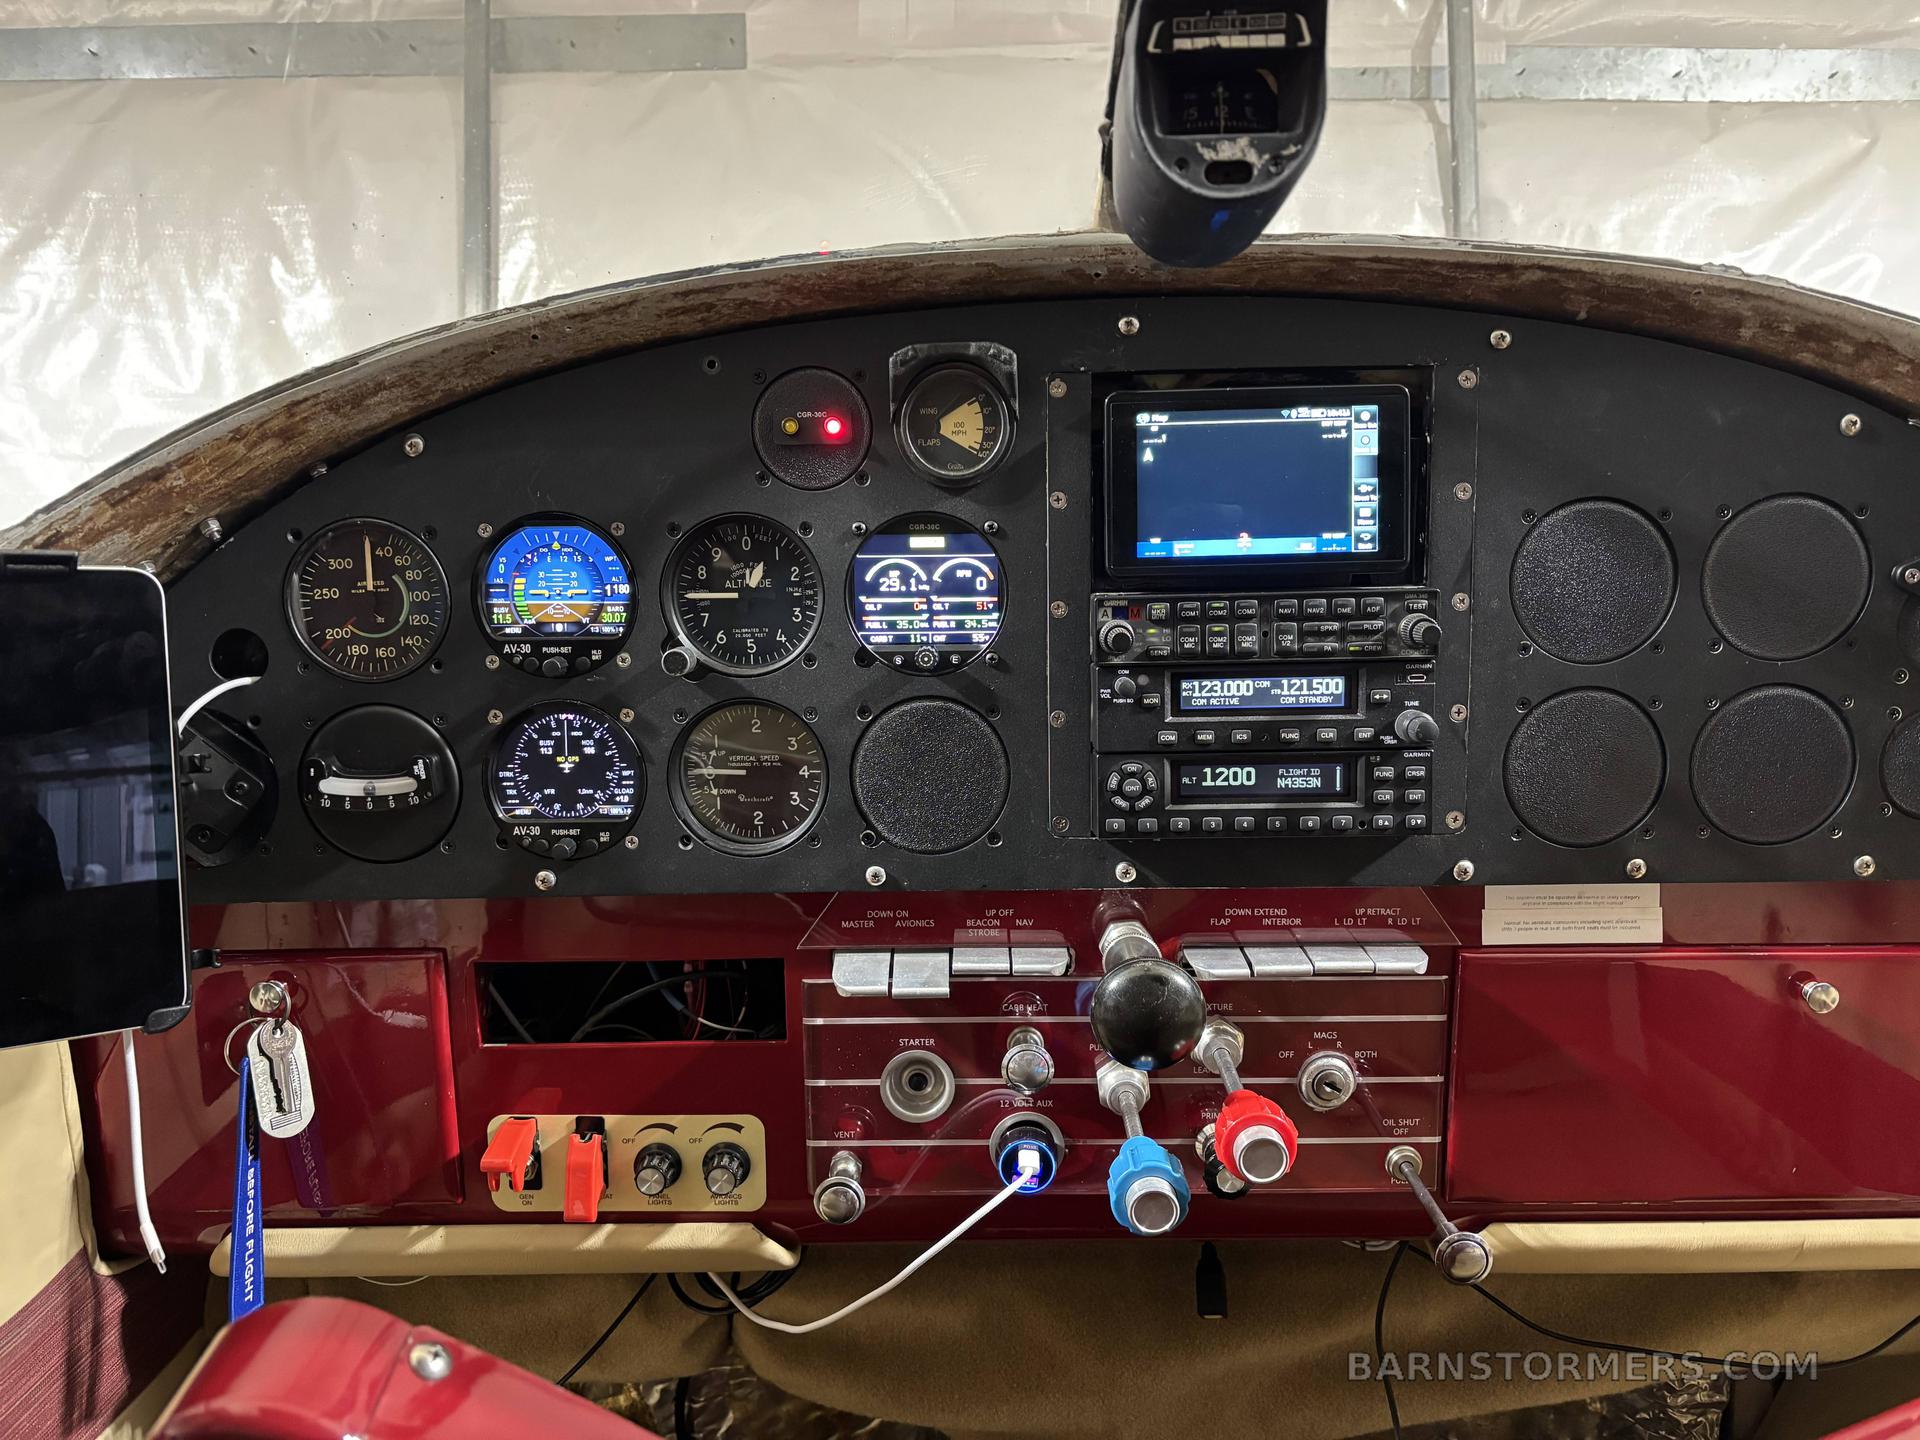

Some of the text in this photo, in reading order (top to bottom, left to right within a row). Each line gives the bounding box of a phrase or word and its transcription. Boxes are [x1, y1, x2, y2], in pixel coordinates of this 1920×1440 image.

[953, 421, 965, 429] 100
[951, 429, 966, 437] MPH
[742, 536, 751, 550] 0
[375, 547, 393, 557] 40
[711, 548, 721, 562] 9
[328, 558, 353, 570] 300
[394, 555, 411, 566] 60
[405, 570, 422, 581] 80
[698, 566, 706, 580] 8
[791, 567, 799, 581] 2
[725, 579, 772, 588] ALTIDE
[314, 588, 339, 599] 250
[409, 591, 430, 602] 100
[409, 615, 429, 625] 120
[492, 614, 512, 624] 11.5
[602, 613, 627, 623] 30.07
[701, 613, 709, 627] 7
[792, 608, 802, 622] 3
[325, 628, 351, 639] 200
[717, 630, 726, 644] 6
[776, 629, 787, 643] 4
[401, 636, 422, 646] 140
[747, 640, 756, 653] 5
[347, 645, 368, 655] 180
[375, 647, 396, 658] 160
[504, 644, 531, 654] AV-30
[1192, 681, 1253, 697] 123.000
[1280, 679, 1342, 695] 121.500
[751, 719, 761, 732] 2
[788, 737, 798, 750] 3
[799, 765, 810, 778] 4
[1202, 767, 1256, 786] 1200
[1277, 777, 1321, 789] N4353N
[790, 792, 800, 805] 3
[754, 811, 764, 824] 2
[514, 826, 540, 836] AV-30
[867, 910, 893, 918] DOWN
[1225, 908, 1288, 916] DOWN EXTEND
[1355, 908, 1400, 916] UP RETRACT
[1262, 918, 1302, 926] INTERIOR
[1027, 1004, 1048, 1012] HEAT
[899, 1038, 935, 1046] STARTER
[246, 1167, 255, 1237] BEFORE
[244, 1238, 254, 1301] FLIGHT
